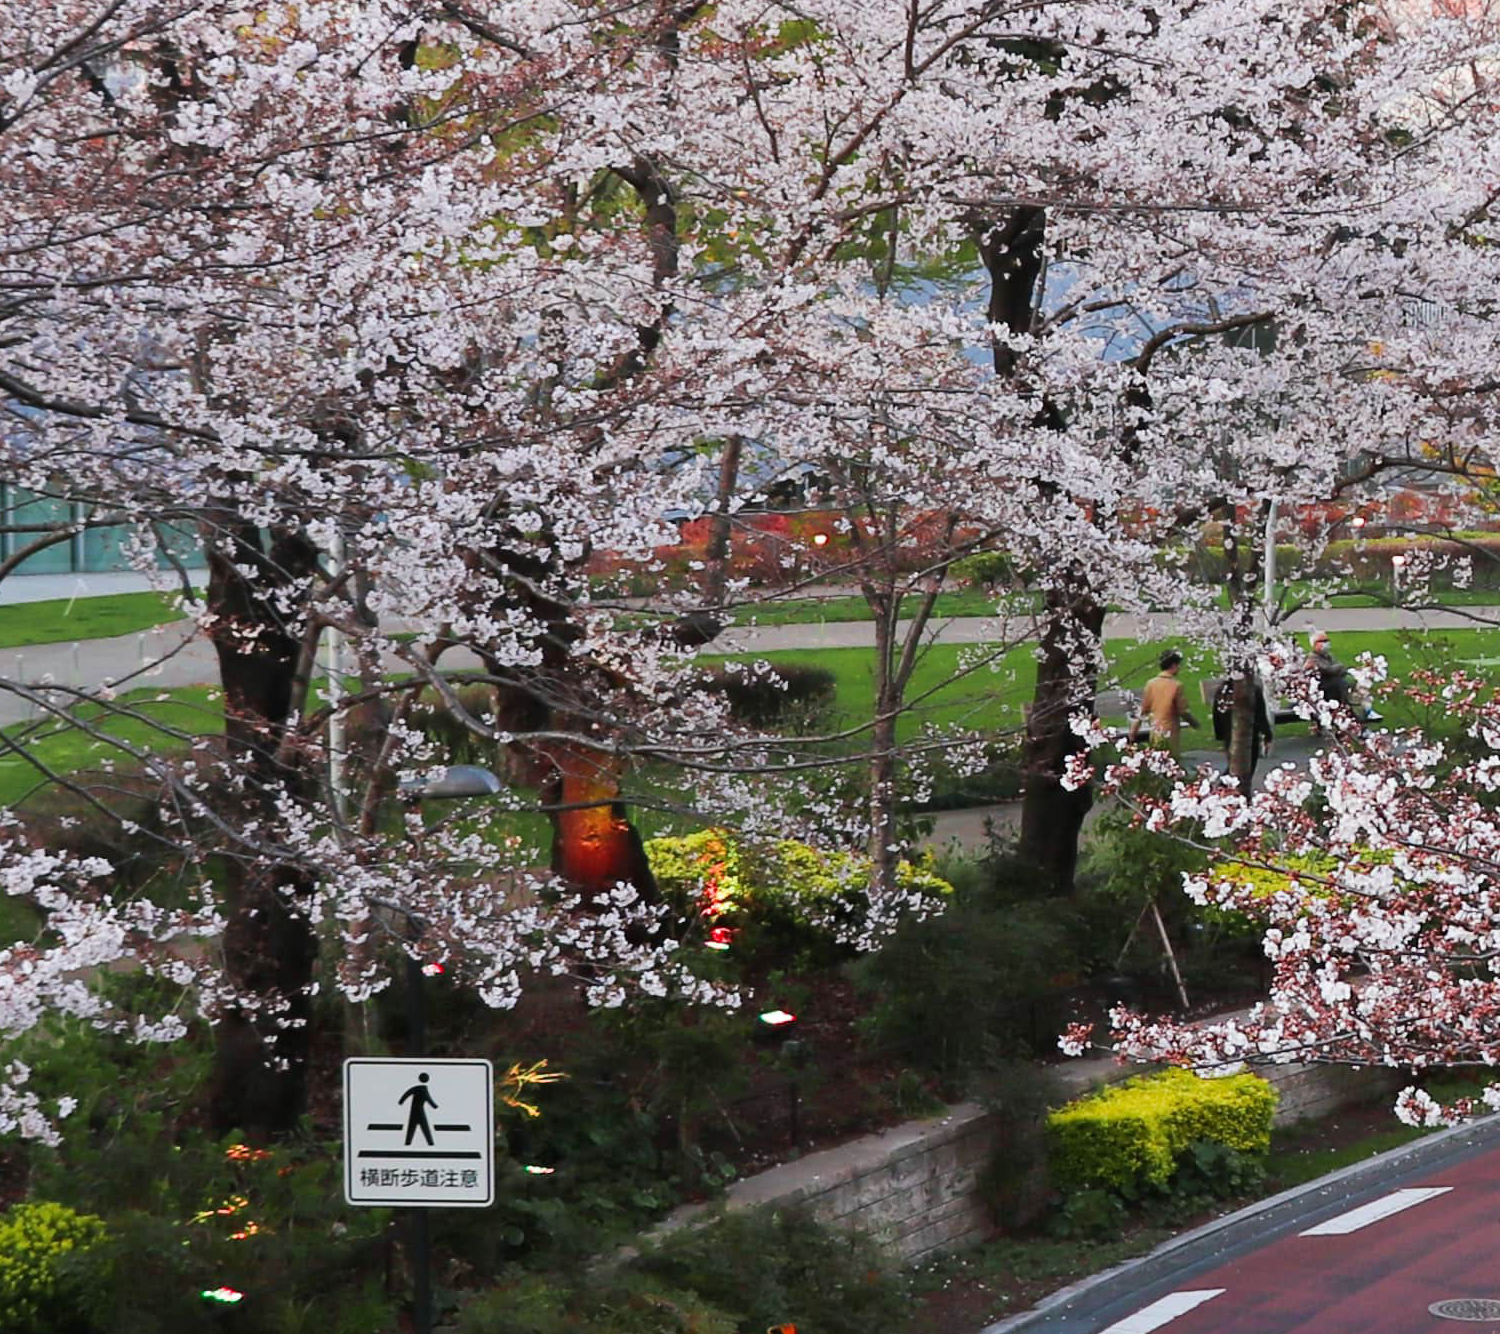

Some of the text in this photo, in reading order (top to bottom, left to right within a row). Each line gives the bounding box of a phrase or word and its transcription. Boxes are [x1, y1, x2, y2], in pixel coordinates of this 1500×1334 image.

[360, 1168, 478, 1188] 横断歩道注意
